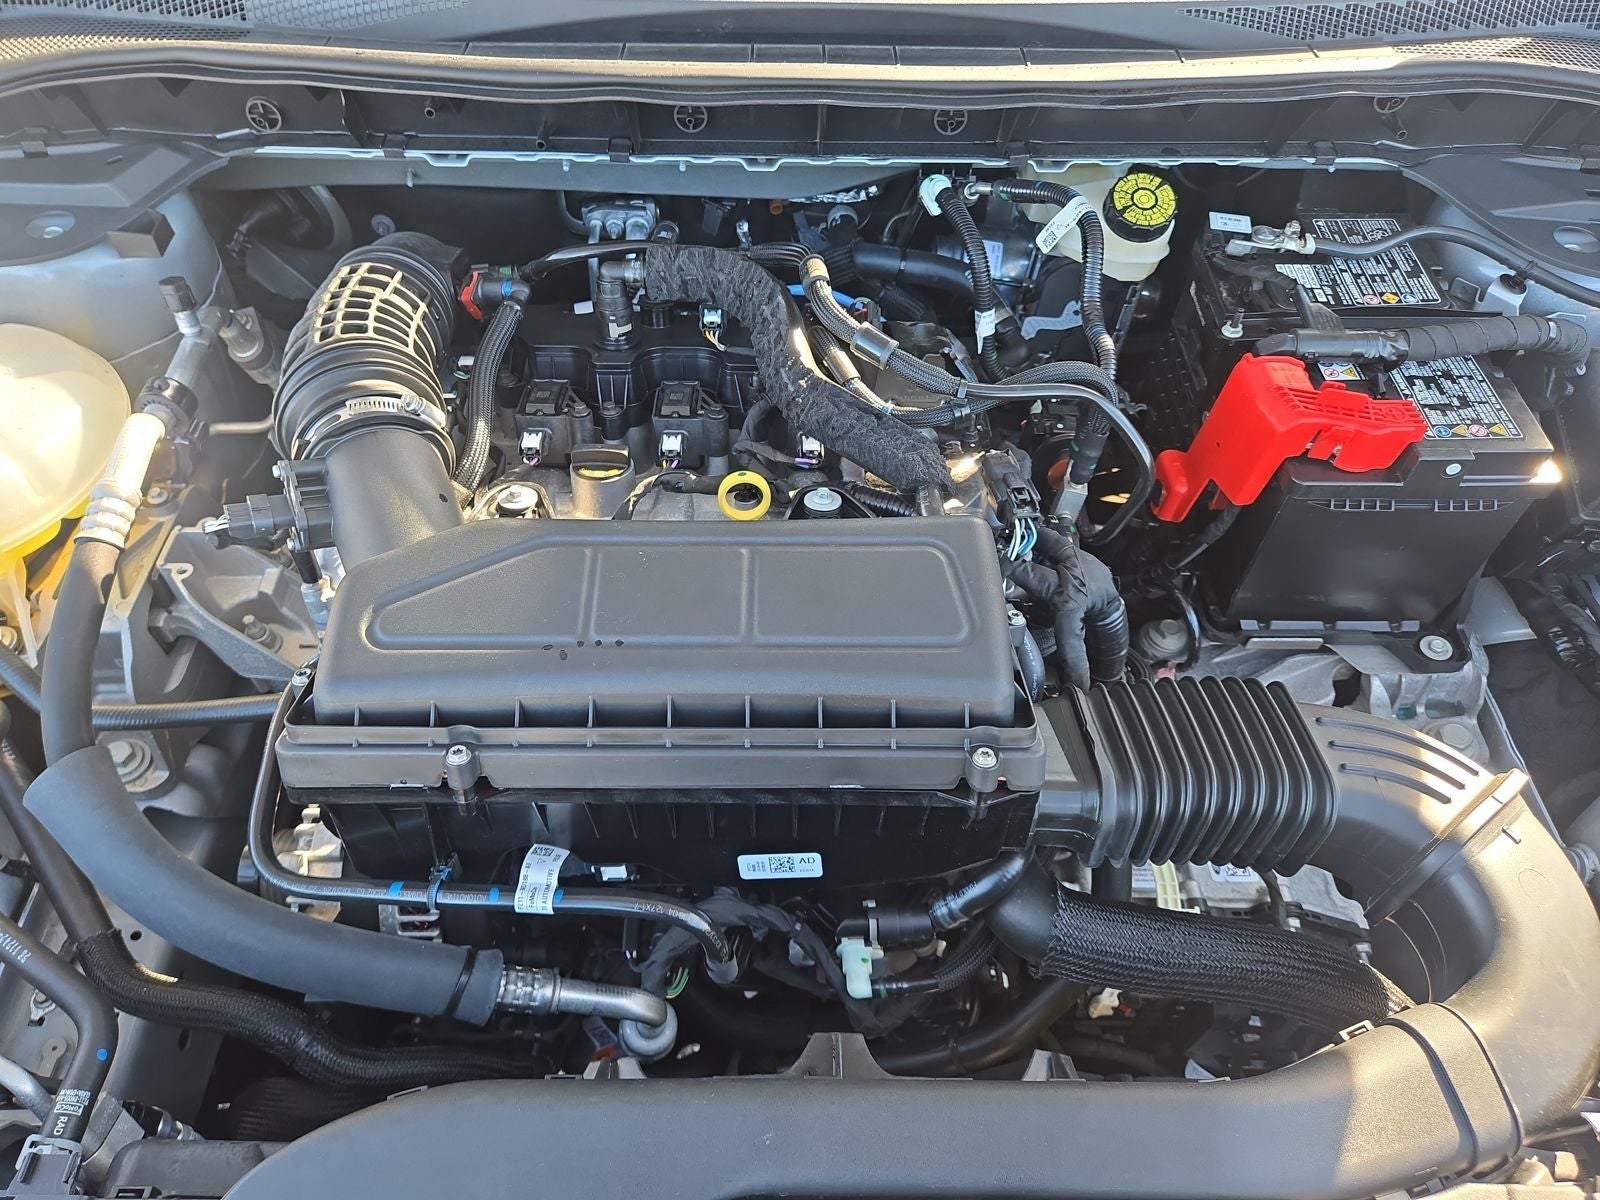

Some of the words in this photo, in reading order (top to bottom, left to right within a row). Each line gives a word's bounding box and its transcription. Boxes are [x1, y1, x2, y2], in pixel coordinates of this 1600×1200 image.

[1313, 264, 1330, 283] FoMoCo
[799, 857, 816, 865] AD
[541, 868, 555, 905] AUTOMOTIVE
[529, 886, 538, 909] FoMoCo
[53, 1116, 69, 1136] RAD
